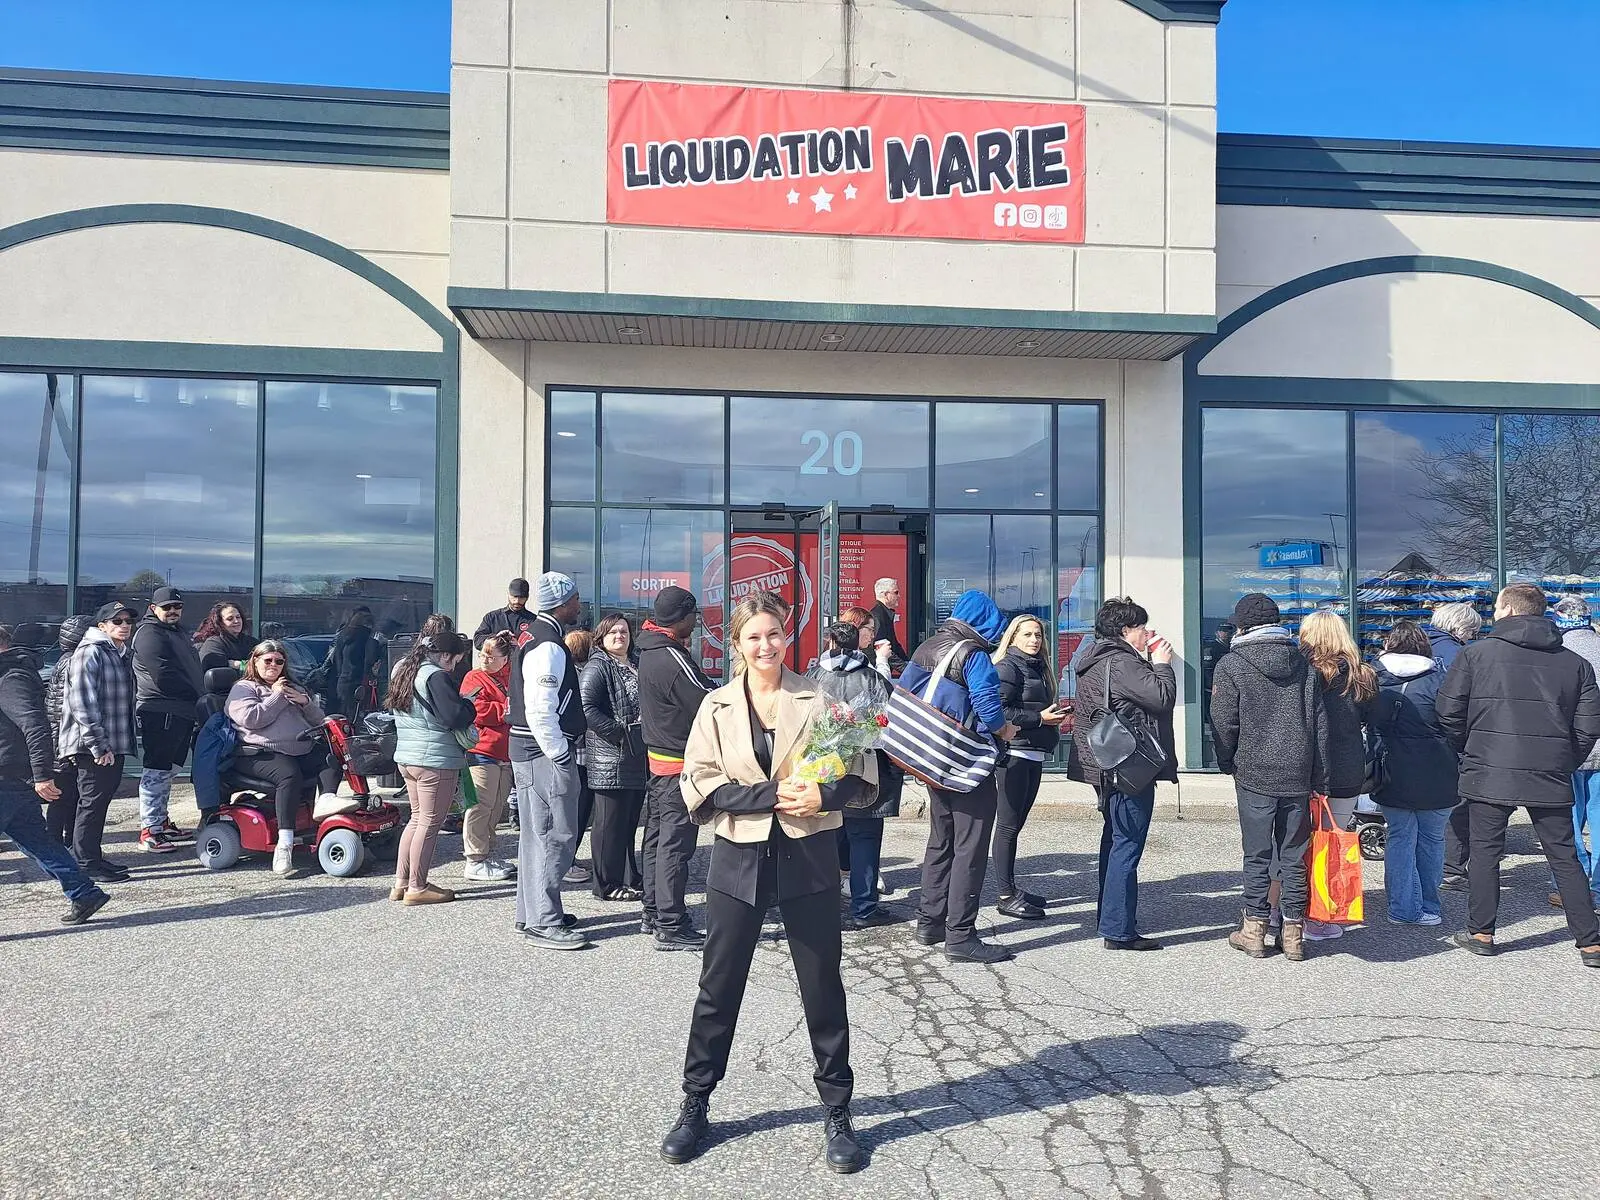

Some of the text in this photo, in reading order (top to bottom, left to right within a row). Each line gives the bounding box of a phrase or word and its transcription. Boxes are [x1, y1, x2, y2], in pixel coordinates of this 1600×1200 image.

[622, 123, 1069, 202] LIQUIDATION MARIE
[800, 429, 863, 476] 20
[707, 571, 789, 604] LIUIDATION
